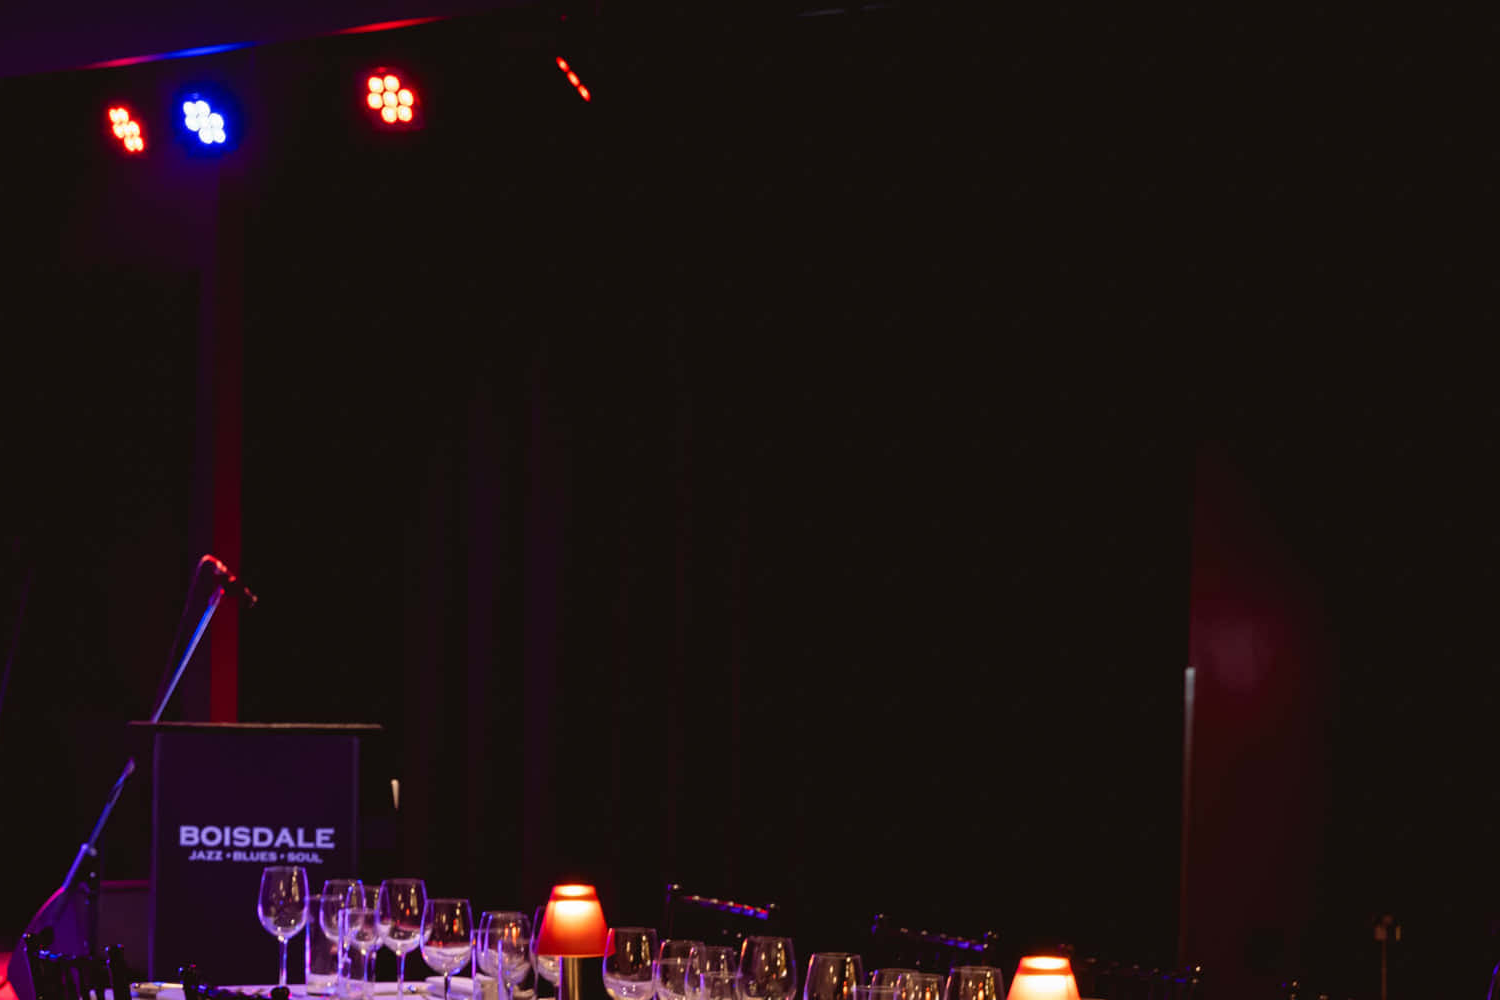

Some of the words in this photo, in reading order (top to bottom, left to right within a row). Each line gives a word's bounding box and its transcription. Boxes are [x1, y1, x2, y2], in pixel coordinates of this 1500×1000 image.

[178, 824, 336, 849] BOISDALE
[188, 849, 224, 862] JAZZ
[232, 851, 278, 863] BLUES
[286, 851, 323, 864] SOUL
